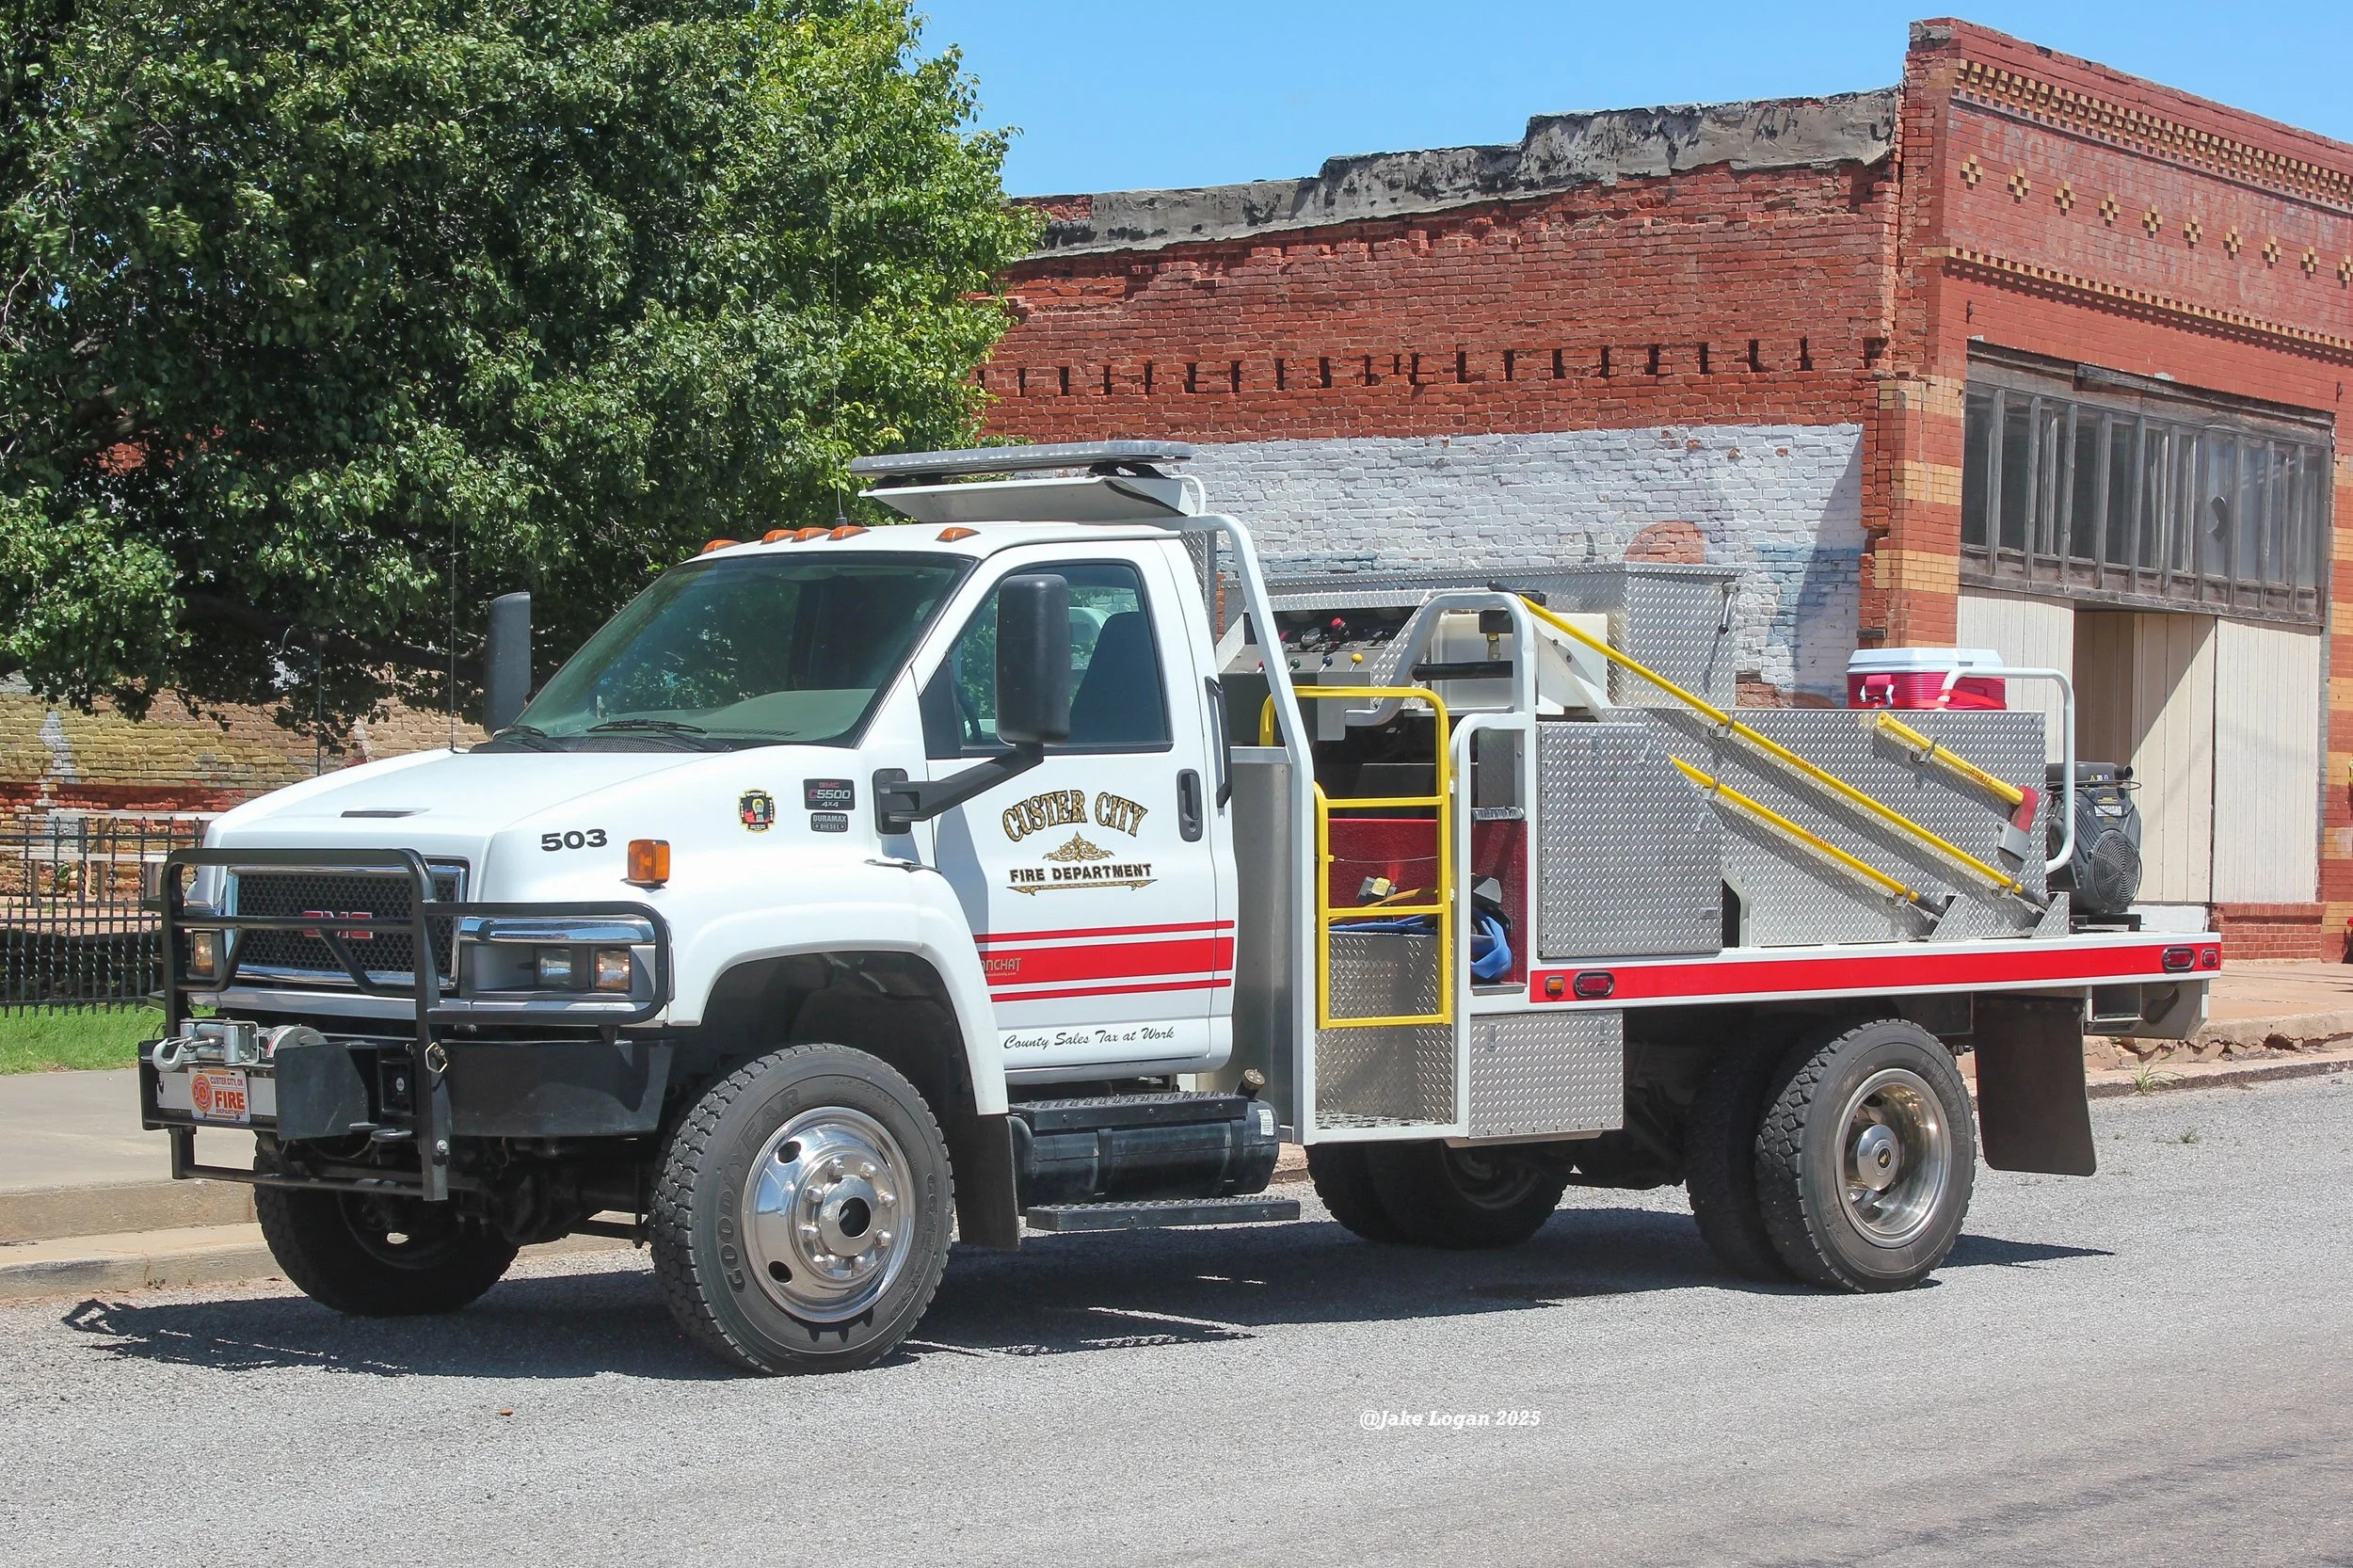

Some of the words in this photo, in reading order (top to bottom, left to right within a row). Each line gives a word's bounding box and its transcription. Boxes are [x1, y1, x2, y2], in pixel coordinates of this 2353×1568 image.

[808, 790, 851, 799] C5500
[812, 814, 846, 823] DURAMAX
[1002, 790, 1088, 842] CUSTER
[1095, 792, 1148, 838] CITY
[541, 829, 607, 852] 503
[1009, 868, 1046, 883] FIRE
[1052, 863, 1152, 880] DEPARTMENT
[1003, 1034, 1049, 1049] County
[1054, 1032, 1090, 1046] Sales
[1095, 1030, 1118, 1043] Tax
[1123, 1031, 1137, 1041] at
[1141, 1026, 1175, 1040] Work
[210, 1076, 227, 1085] CUSTER
[215, 1090, 246, 1110] FIRE
